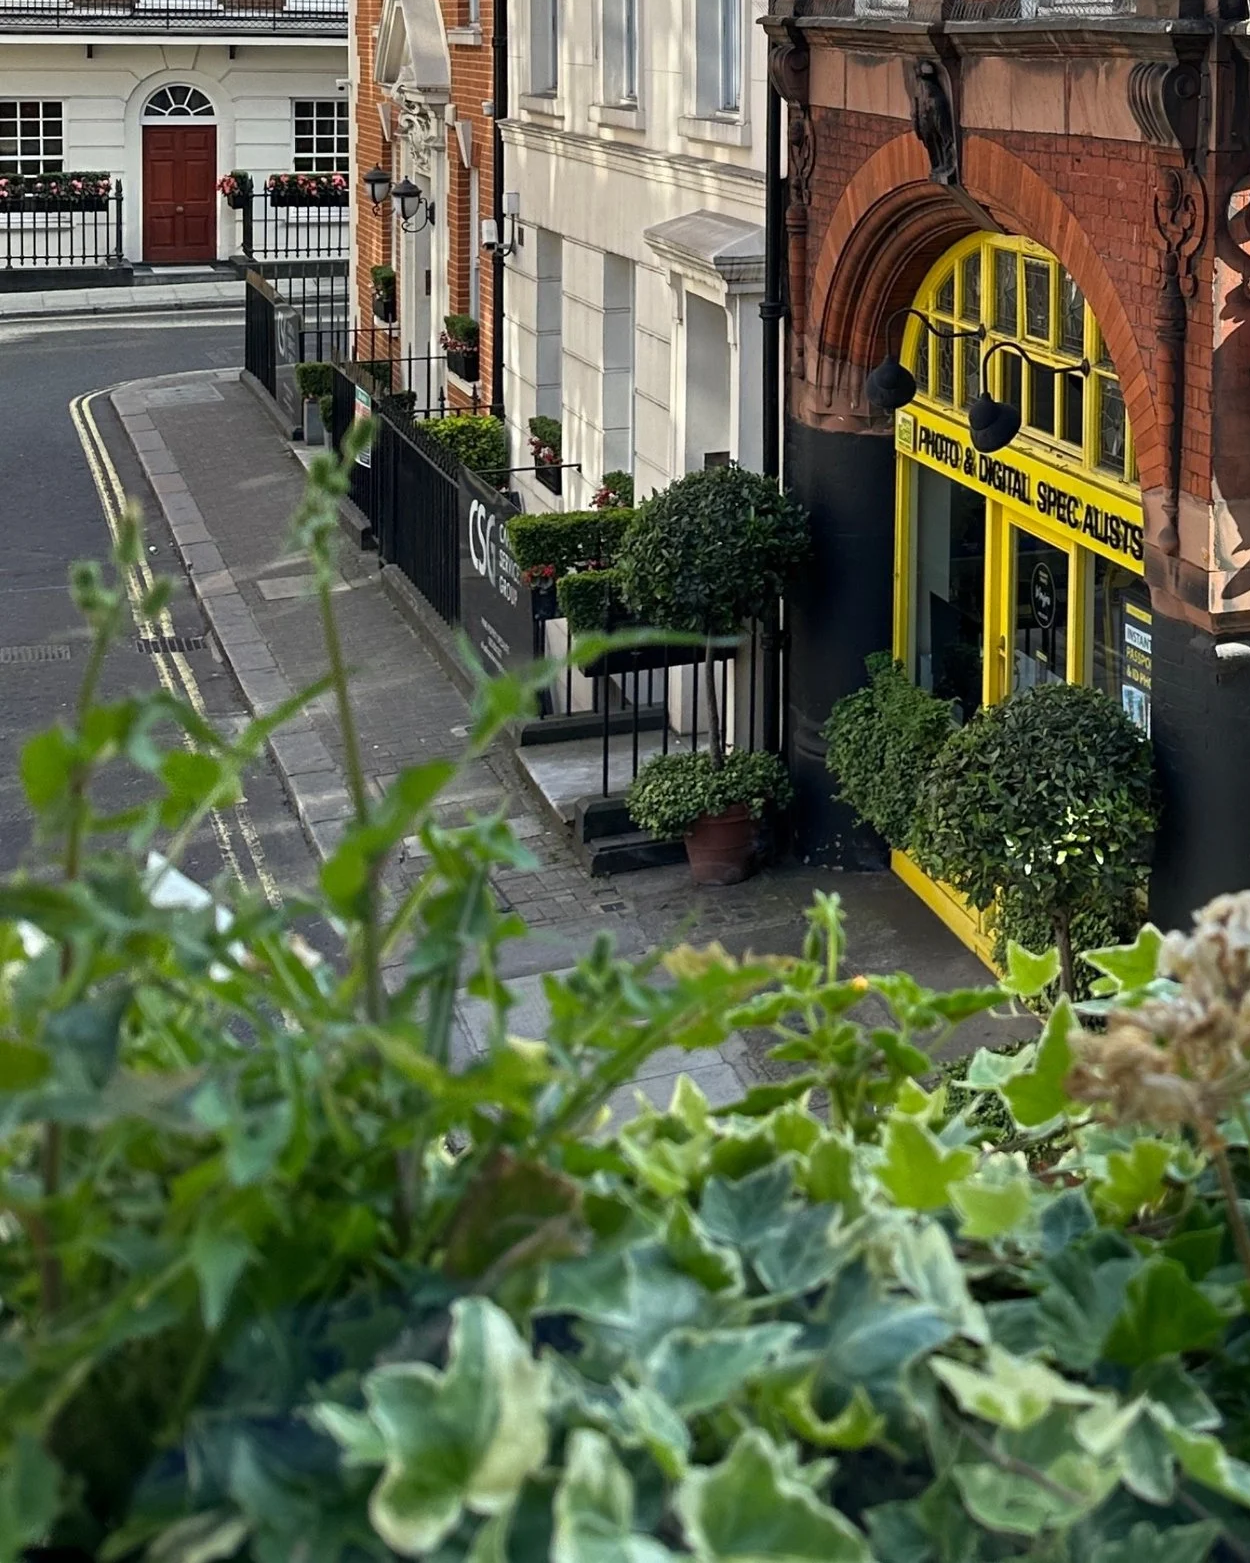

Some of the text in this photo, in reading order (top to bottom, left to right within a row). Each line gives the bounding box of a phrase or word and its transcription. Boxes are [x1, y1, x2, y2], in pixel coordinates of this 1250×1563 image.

[918, 425, 963, 469] PHOTO
[964, 446, 975, 478] &
[979, 454, 1032, 506] DIGITAL
[469, 499, 497, 588] CSG
